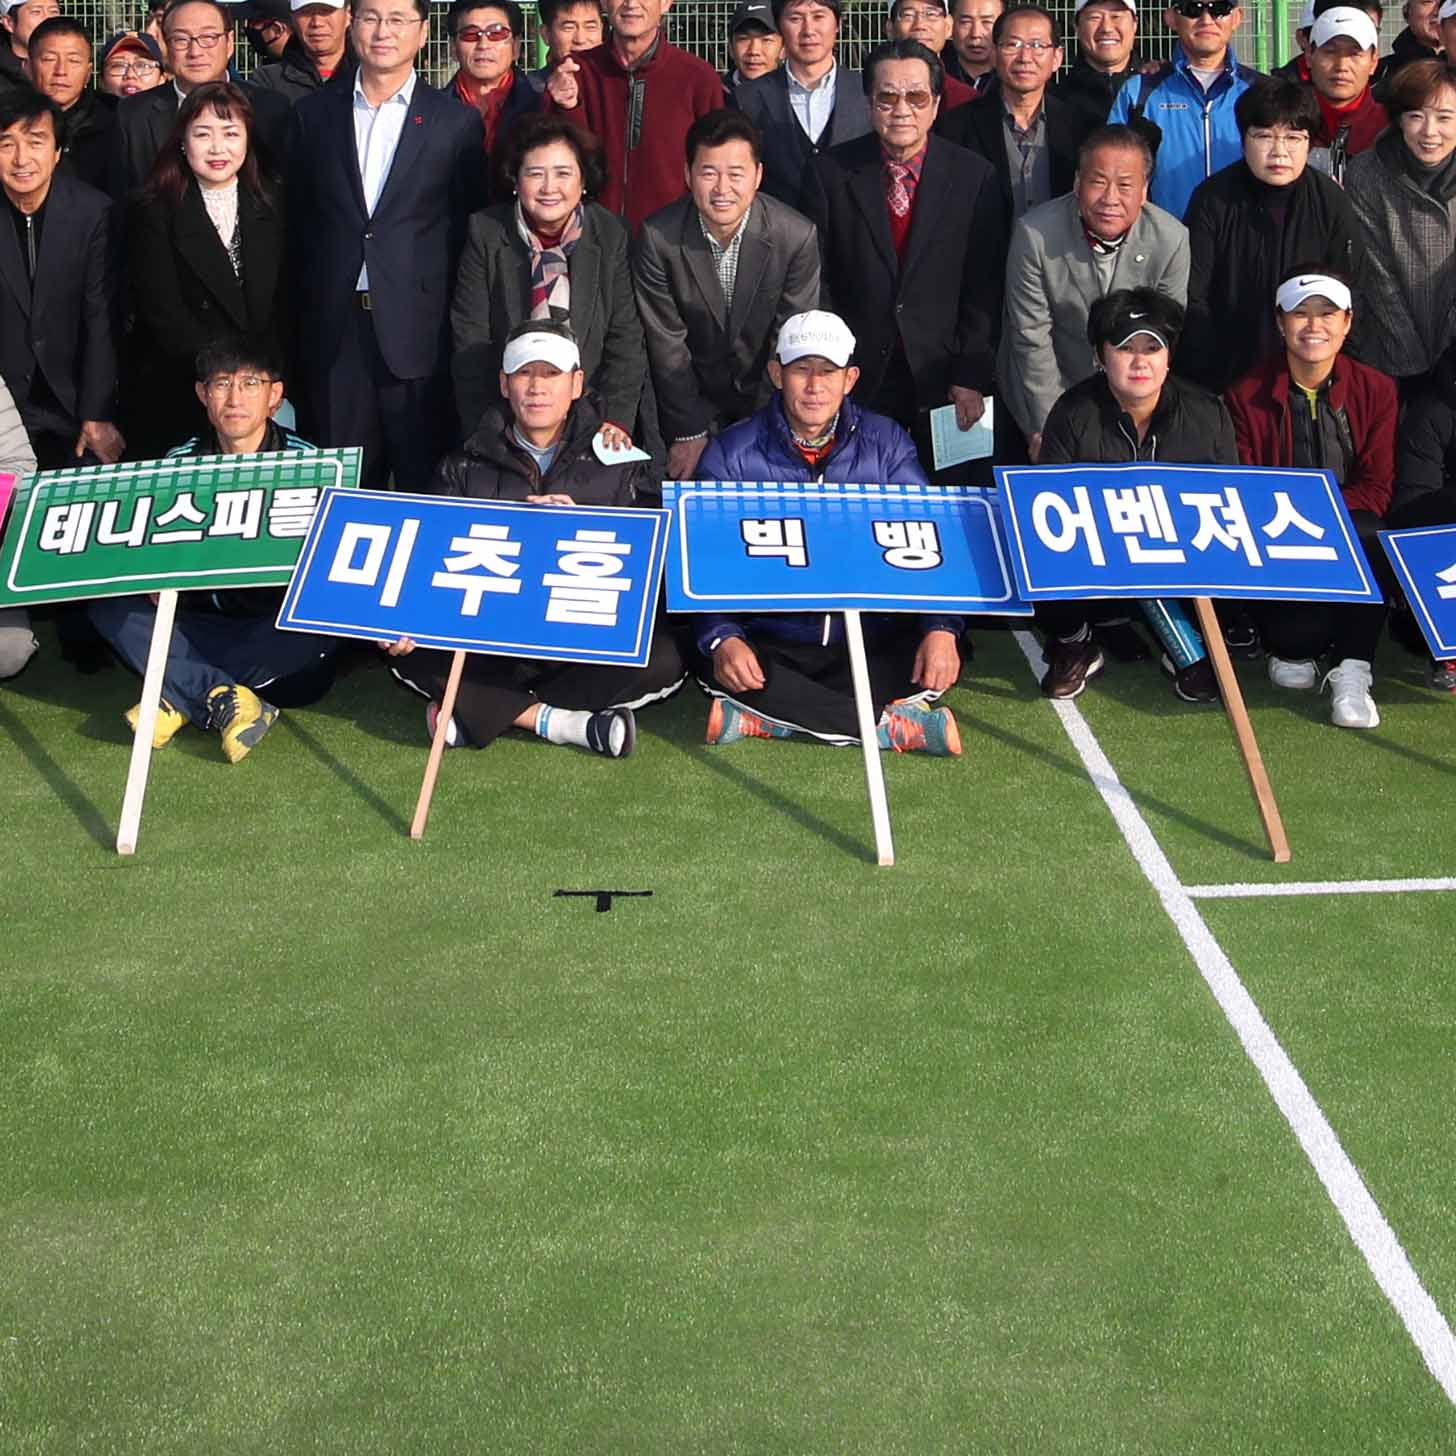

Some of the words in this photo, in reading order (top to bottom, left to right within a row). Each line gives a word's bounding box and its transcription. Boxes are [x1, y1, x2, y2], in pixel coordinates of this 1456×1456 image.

[38, 485, 322, 556] 테니스피플
[1030, 484, 1339, 567] 어벤져스
[326, 518, 634, 627] 미추홀
